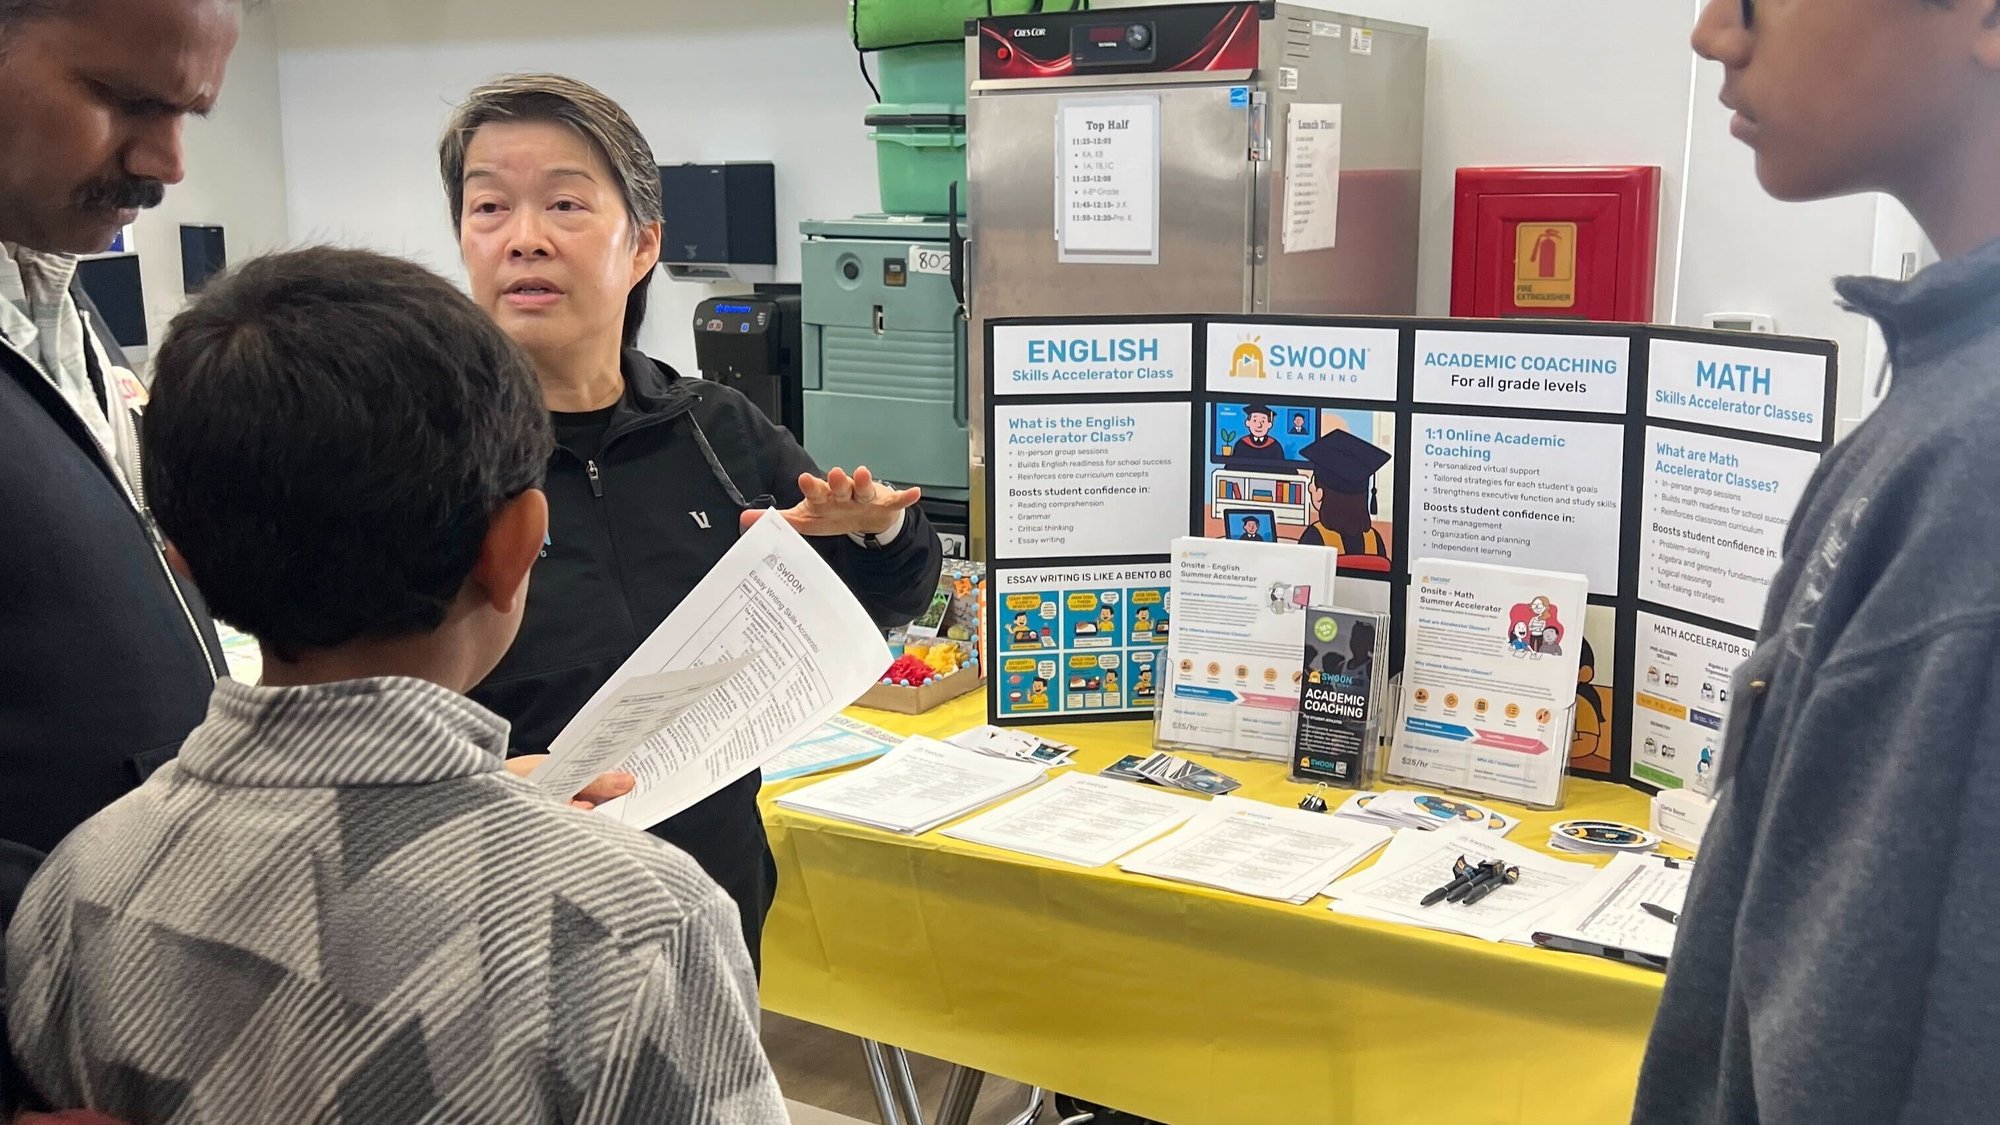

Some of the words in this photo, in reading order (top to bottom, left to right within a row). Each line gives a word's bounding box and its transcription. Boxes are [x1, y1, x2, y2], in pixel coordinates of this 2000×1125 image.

[1086, 120, 1104, 132] Top
[1108, 120, 1129, 130] Half
[1298, 120, 1318, 130] Lunch
[1516, 284, 1532, 292] FIRE
[1028, 338, 1158, 363] ENGLISH
[1269, 344, 1366, 370] SWOON
[1424, 352, 1517, 370] ACADEMIC
[1521, 356, 1618, 374] COACHING
[1012, 370, 1049, 382] Skills
[1052, 368, 1134, 380] Accelerator
[1137, 368, 1174, 379] Class
[1276, 371, 1358, 383] LEARNING
[1451, 374, 1475, 387] For
[1478, 376, 1494, 388] all
[1498, 378, 1540, 392] grade
[1544, 379, 1587, 393] levels
[1696, 360, 1771, 396] MATH
[1655, 389, 1686, 406] Skills
[1688, 394, 1762, 416] Accelerator
[1764, 404, 1814, 424] Classes
[1008, 418, 1042, 429] What
[1046, 418, 1056, 428] is
[1060, 417, 1082, 428] the
[1086, 416, 1135, 430] English
[1008, 432, 1087, 444] Accelerator
[1090, 431, 1134, 442] Class?
[1425, 428, 1443, 440] 1:1
[1446, 429, 1491, 443] Online
[1494, 432, 1566, 448] Academic
[1018, 448, 1054, 457] In-person
[1054, 448, 1076, 456] group
[1078, 447, 1108, 455] sessions
[1425, 444, 1491, 462] Coaching
[1656, 442, 1685, 458] What
[1688, 449, 1706, 462] are
[1709, 450, 1739, 468] Math
[1042, 460, 1068, 469] English
[1070, 459, 1104, 467] readiness
[1106, 458, 1116, 466] for
[1118, 458, 1140, 466] school
[1142, 458, 1172, 466] success
[1433, 462, 1482, 472] Personalized
[1483, 466, 1508, 474] virtual
[1510, 467, 1540, 476] support
[1018, 472, 1056, 480] Reinforces
[1058, 472, 1074, 480] core
[1116, 470, 1149, 478] concepts
[1433, 474, 1462, 484] Tailored
[1464, 477, 1502, 488] strategies
[1504, 479, 1515, 487] for
[1516, 480, 1536, 488] each
[1538, 482, 1574, 492] student's
[1576, 485, 1598, 494] goals
[1655, 460, 1723, 483] Accelerator
[1725, 472, 1779, 494] Classes?
[1009, 488, 1042, 496] Boosts
[1044, 487, 1082, 496] student
[1084, 486, 1136, 495] confidence
[1138, 486, 1150, 494] in:
[1432, 487, 1480, 498] Strengthens
[1481, 491, 1518, 500] executive
[1520, 493, 1554, 504] function
[1555, 496, 1570, 505] and
[1572, 498, 1596, 508] study
[1597, 500, 1617, 508] skills
[1662, 480, 1692, 492] In-person
[1694, 486, 1712, 496] group
[1714, 489, 1742, 501] sessions
[1018, 501, 1047, 510] Reading
[1049, 500, 1104, 508] comprehension
[1423, 502, 1458, 514] Boosts
[1460, 505, 1500, 517] student
[1502, 508, 1560, 522] confidence
[1562, 513, 1576, 523] in:
[1681, 497, 1698, 508] math
[1700, 501, 1730, 514] readiness
[1731, 507, 1741, 516] for
[1742, 509, 1764, 520] school
[1045, 524, 1074, 532] thinking
[1432, 517, 1450, 525] Time
[1452, 519, 1502, 530] management
[1660, 507, 1694, 521] Reinforces
[1695, 514, 1727, 528] classroom
[1728, 522, 1764, 535] curriculum
[1018, 537, 1038, 545] Essay
[1040, 536, 1066, 544] writing
[1431, 530, 1479, 541] Organization
[1480, 534, 1496, 542] and
[1496, 536, 1531, 546] planning
[1652, 522, 1680, 536] Boosts
[1682, 530, 1716, 545] student
[1717, 538, 1765, 557] confidence
[1766, 550, 1778, 559] in:
[1431, 542, 1479, 553] Independent
[1480, 546, 1512, 558] learning
[1660, 540, 1710, 559] Problem-solving
[1180, 562, 1206, 570] Onsite
[1212, 564, 1240, 572] English
[1658, 553, 1682, 566] Algebra
[1684, 558, 1696, 568] and
[1696, 562, 1726, 577] geometry
[776, 562, 804, 594] SWOON
[1007, 574, 1038, 584] ESSAY
[1040, 573, 1080, 584] WRITING
[1082, 573, 1092, 582] IS
[1094, 572, 1114, 580] LIKE
[1116, 572, 1124, 580] A
[1125, 570, 1157, 580] BENTO
[1180, 570, 1212, 580] Summer
[1213, 573, 1257, 582] Accelerator
[1658, 567, 1680, 579] Logical
[1681, 573, 1712, 588] reasoning
[749, 570, 767, 590] Essay
[766, 587, 785, 612] Writing
[783, 607, 798, 624] Skills
[1420, 586, 1447, 596] Onsite
[1454, 591, 1474, 600] Math
[1658, 580, 1692, 596] Test-taking
[1693, 588, 1724, 604] strategies
[1420, 596, 1453, 608] Summer
[1454, 600, 1502, 613] Accelerator
[1654, 624, 1678, 638] MATH
[1678, 630, 1740, 656] ACCELERATOR
[1322, 672, 1352, 684] SWOON
[1306, 688, 1365, 706] ACADEMIC
[1304, 700, 1364, 718] COACHING
[1402, 756, 1428, 768] $25/hr
